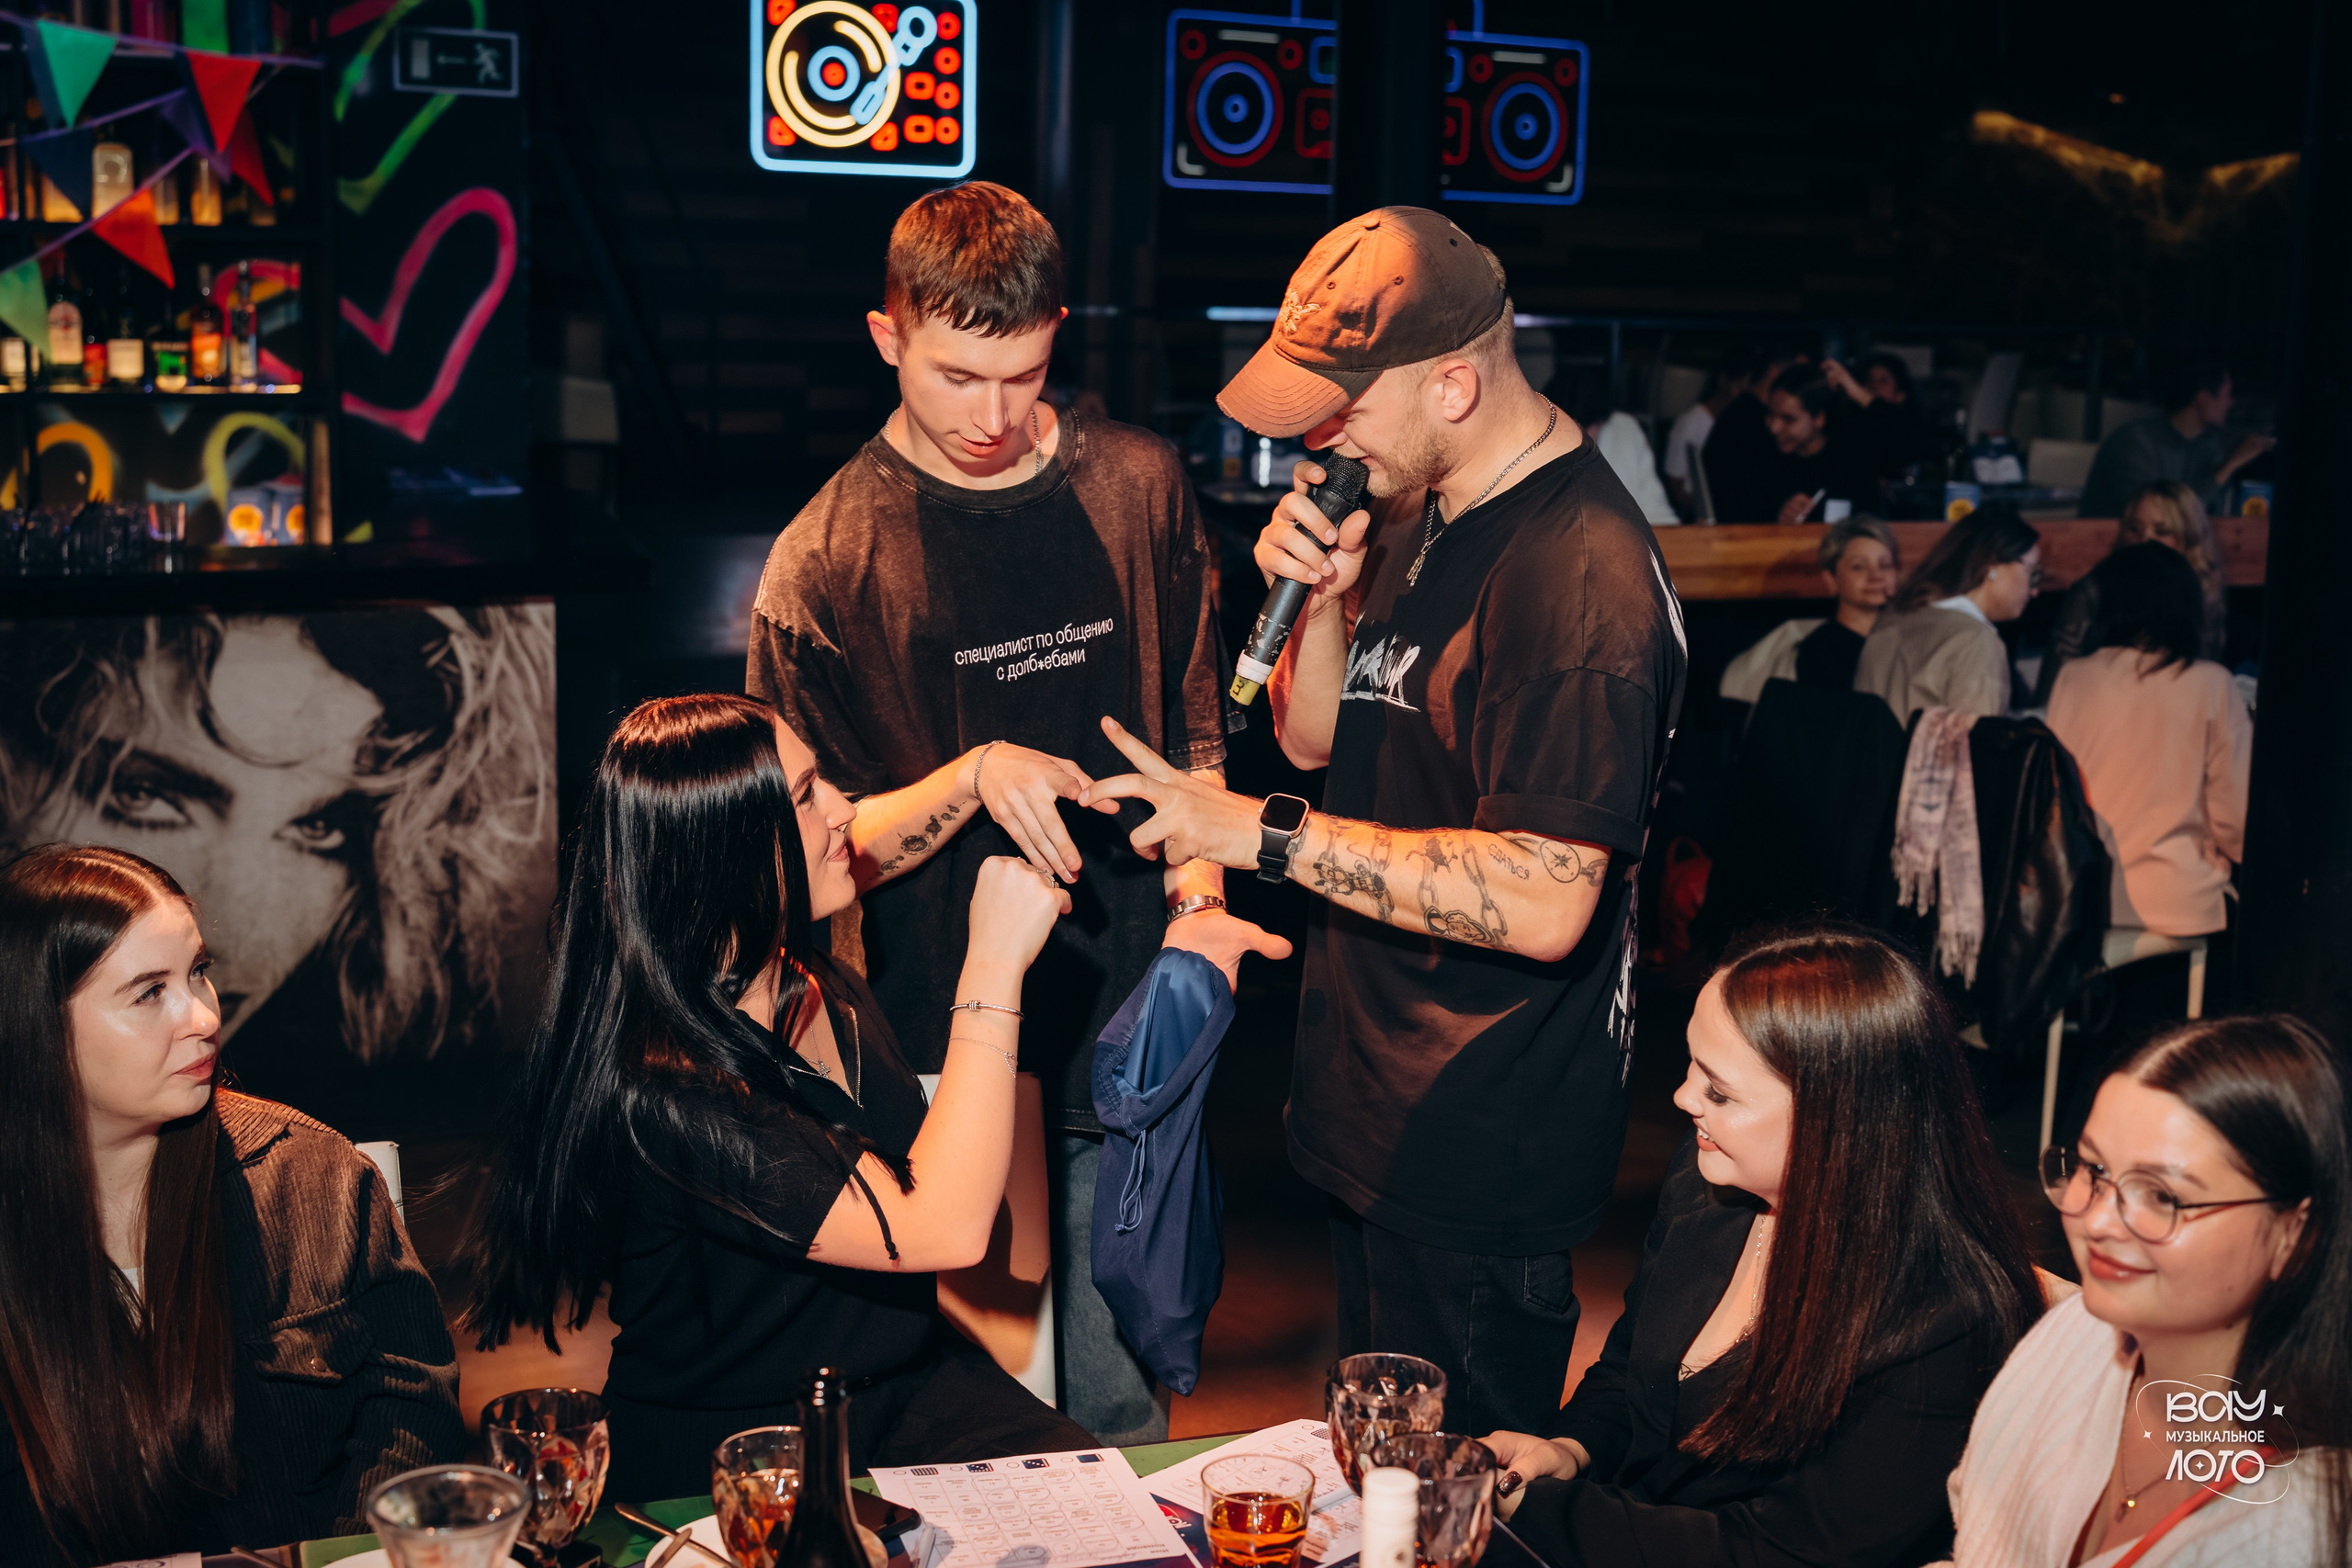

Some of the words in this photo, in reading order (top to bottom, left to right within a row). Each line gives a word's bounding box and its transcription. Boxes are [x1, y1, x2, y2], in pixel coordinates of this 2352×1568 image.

[955, 636, 1035, 666] специалист
[1035, 632, 1054, 649] по
[1056, 617, 1114, 644] общению
[996, 666, 1005, 681] с
